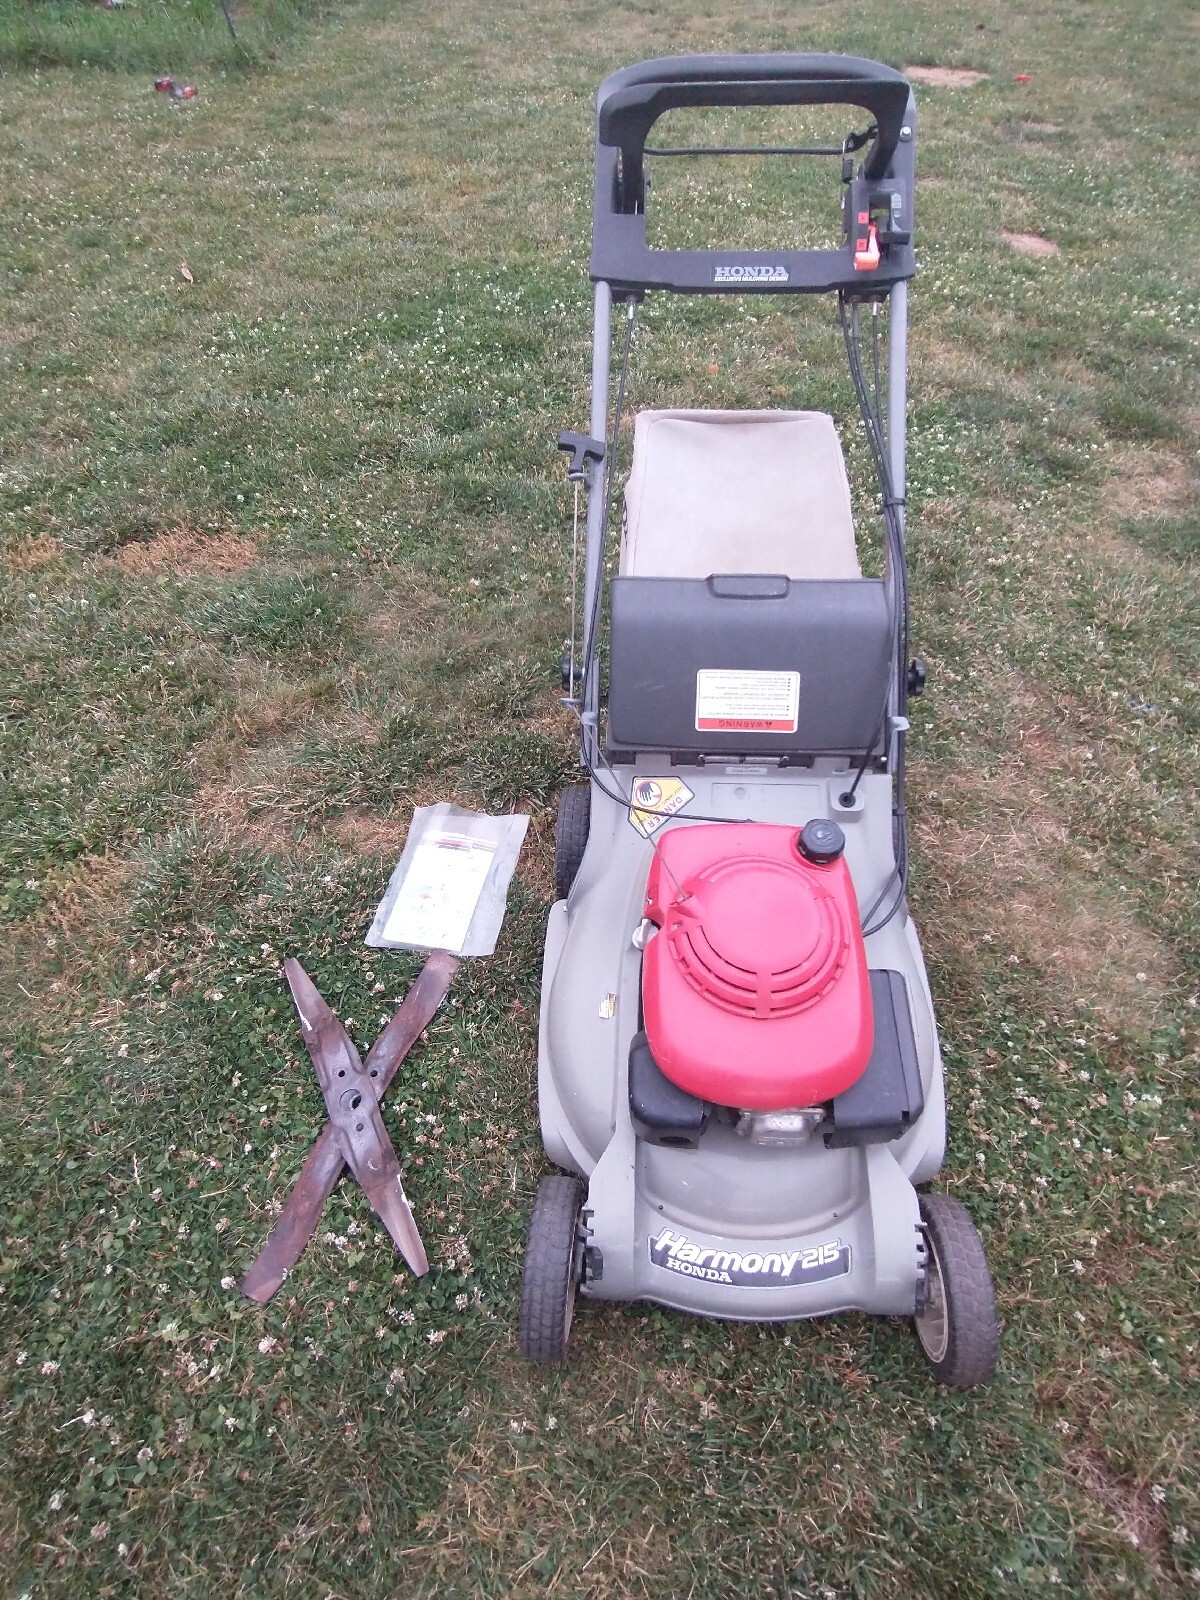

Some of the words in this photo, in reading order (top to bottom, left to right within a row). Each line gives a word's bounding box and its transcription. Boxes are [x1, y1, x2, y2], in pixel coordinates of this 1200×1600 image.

[715, 266, 789, 277] HONDA
[718, 719, 763, 728] WARNING
[655, 1230, 800, 1277] Harmony
[801, 1241, 841, 1270] 215
[666, 1257, 733, 1283] HONDA
